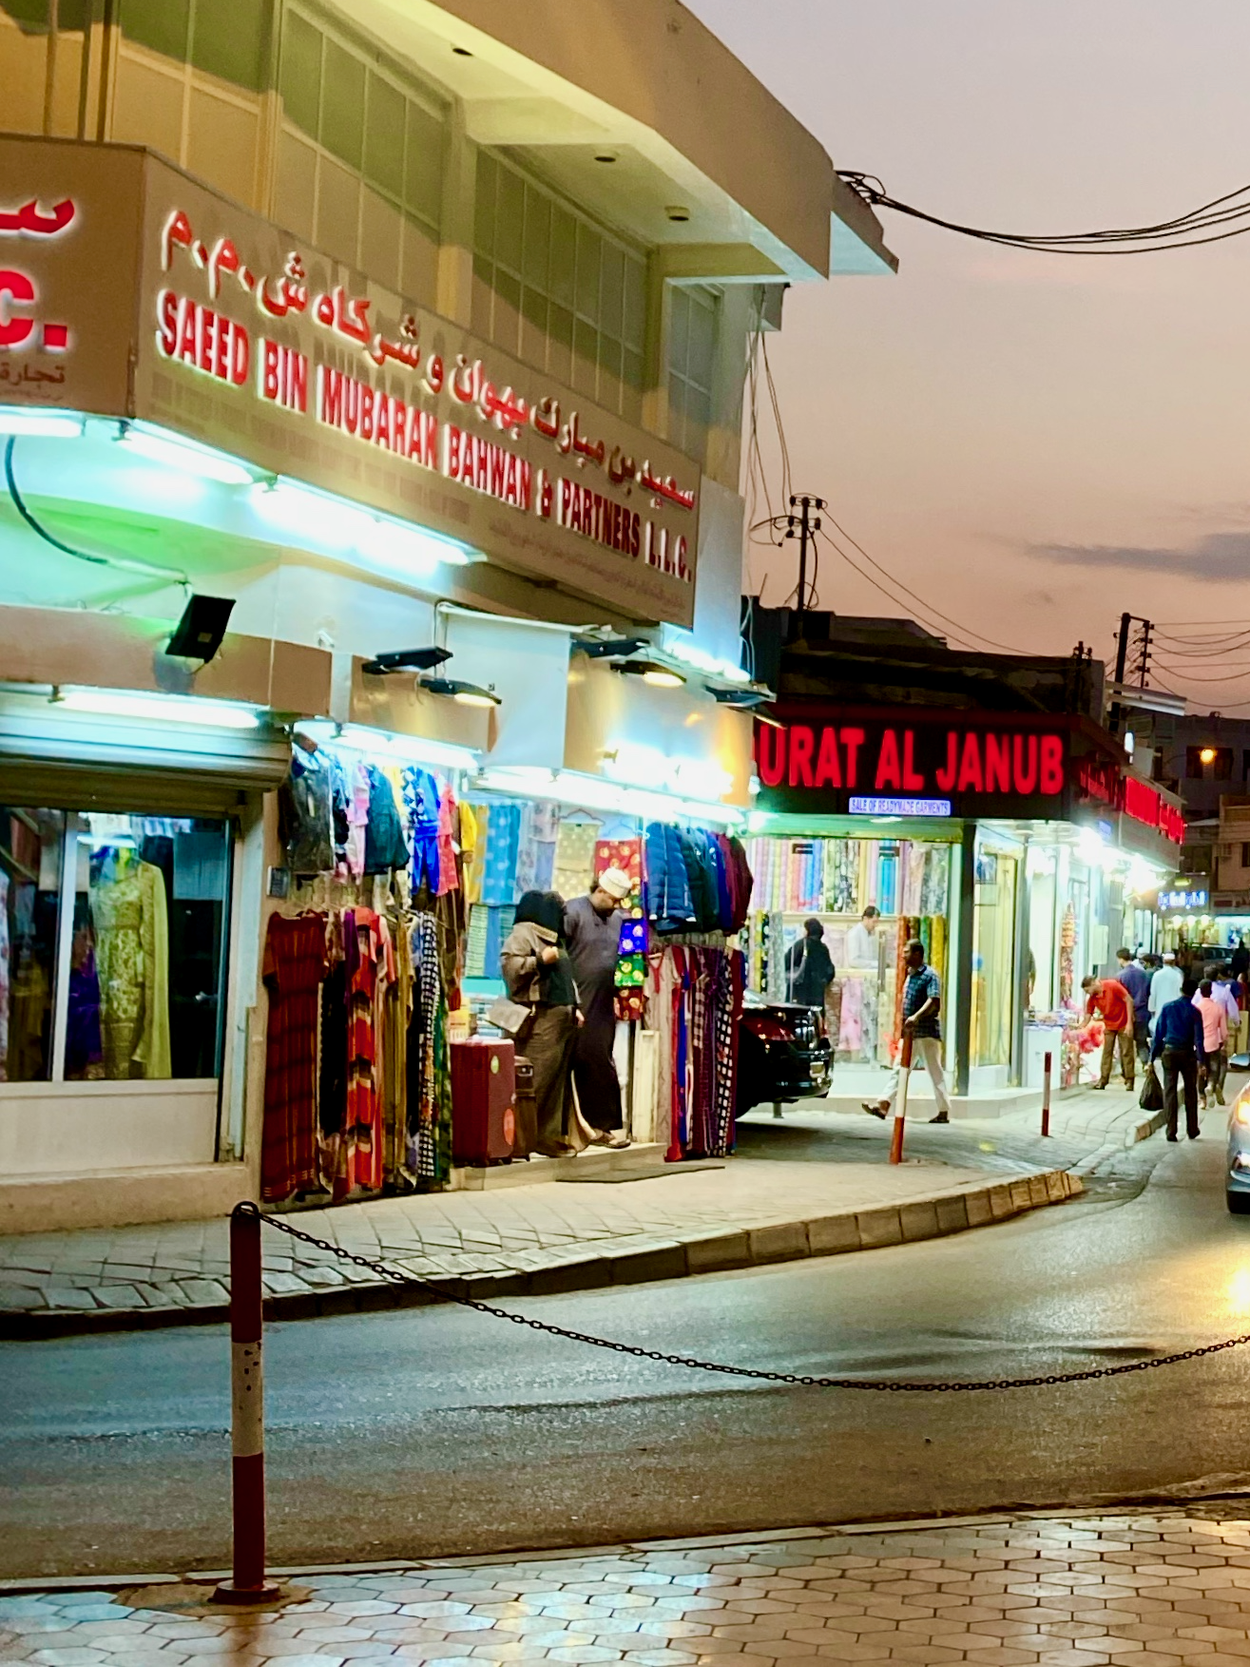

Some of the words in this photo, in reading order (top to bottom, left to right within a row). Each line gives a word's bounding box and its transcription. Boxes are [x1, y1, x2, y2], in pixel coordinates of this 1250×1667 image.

[312, 285, 421, 370] شركاه
[422, 354, 443, 395] و
[449, 354, 529, 440] بهوان
[156, 288, 249, 388] SAEED
[258, 337, 308, 415] BIN
[317, 364, 438, 470] MUBARAK
[442, 423, 531, 510] BAHWAN
[536, 468, 553, 518] &
[557, 477, 640, 558] PARTNERS
[645, 521, 692, 583] L.L.C.
[608, 446, 636, 497] بن
[636, 459, 695, 510] سعيد
[751, 724, 865, 788] URAT
[874, 729, 924, 791] AL
[936, 732, 1063, 795] JANUB
[851, 798, 868, 812] SALE
[869, 798, 877, 812] OF
[878, 799, 914, 813] READYMADE
[915, 800, 948, 814] GARMENTS
